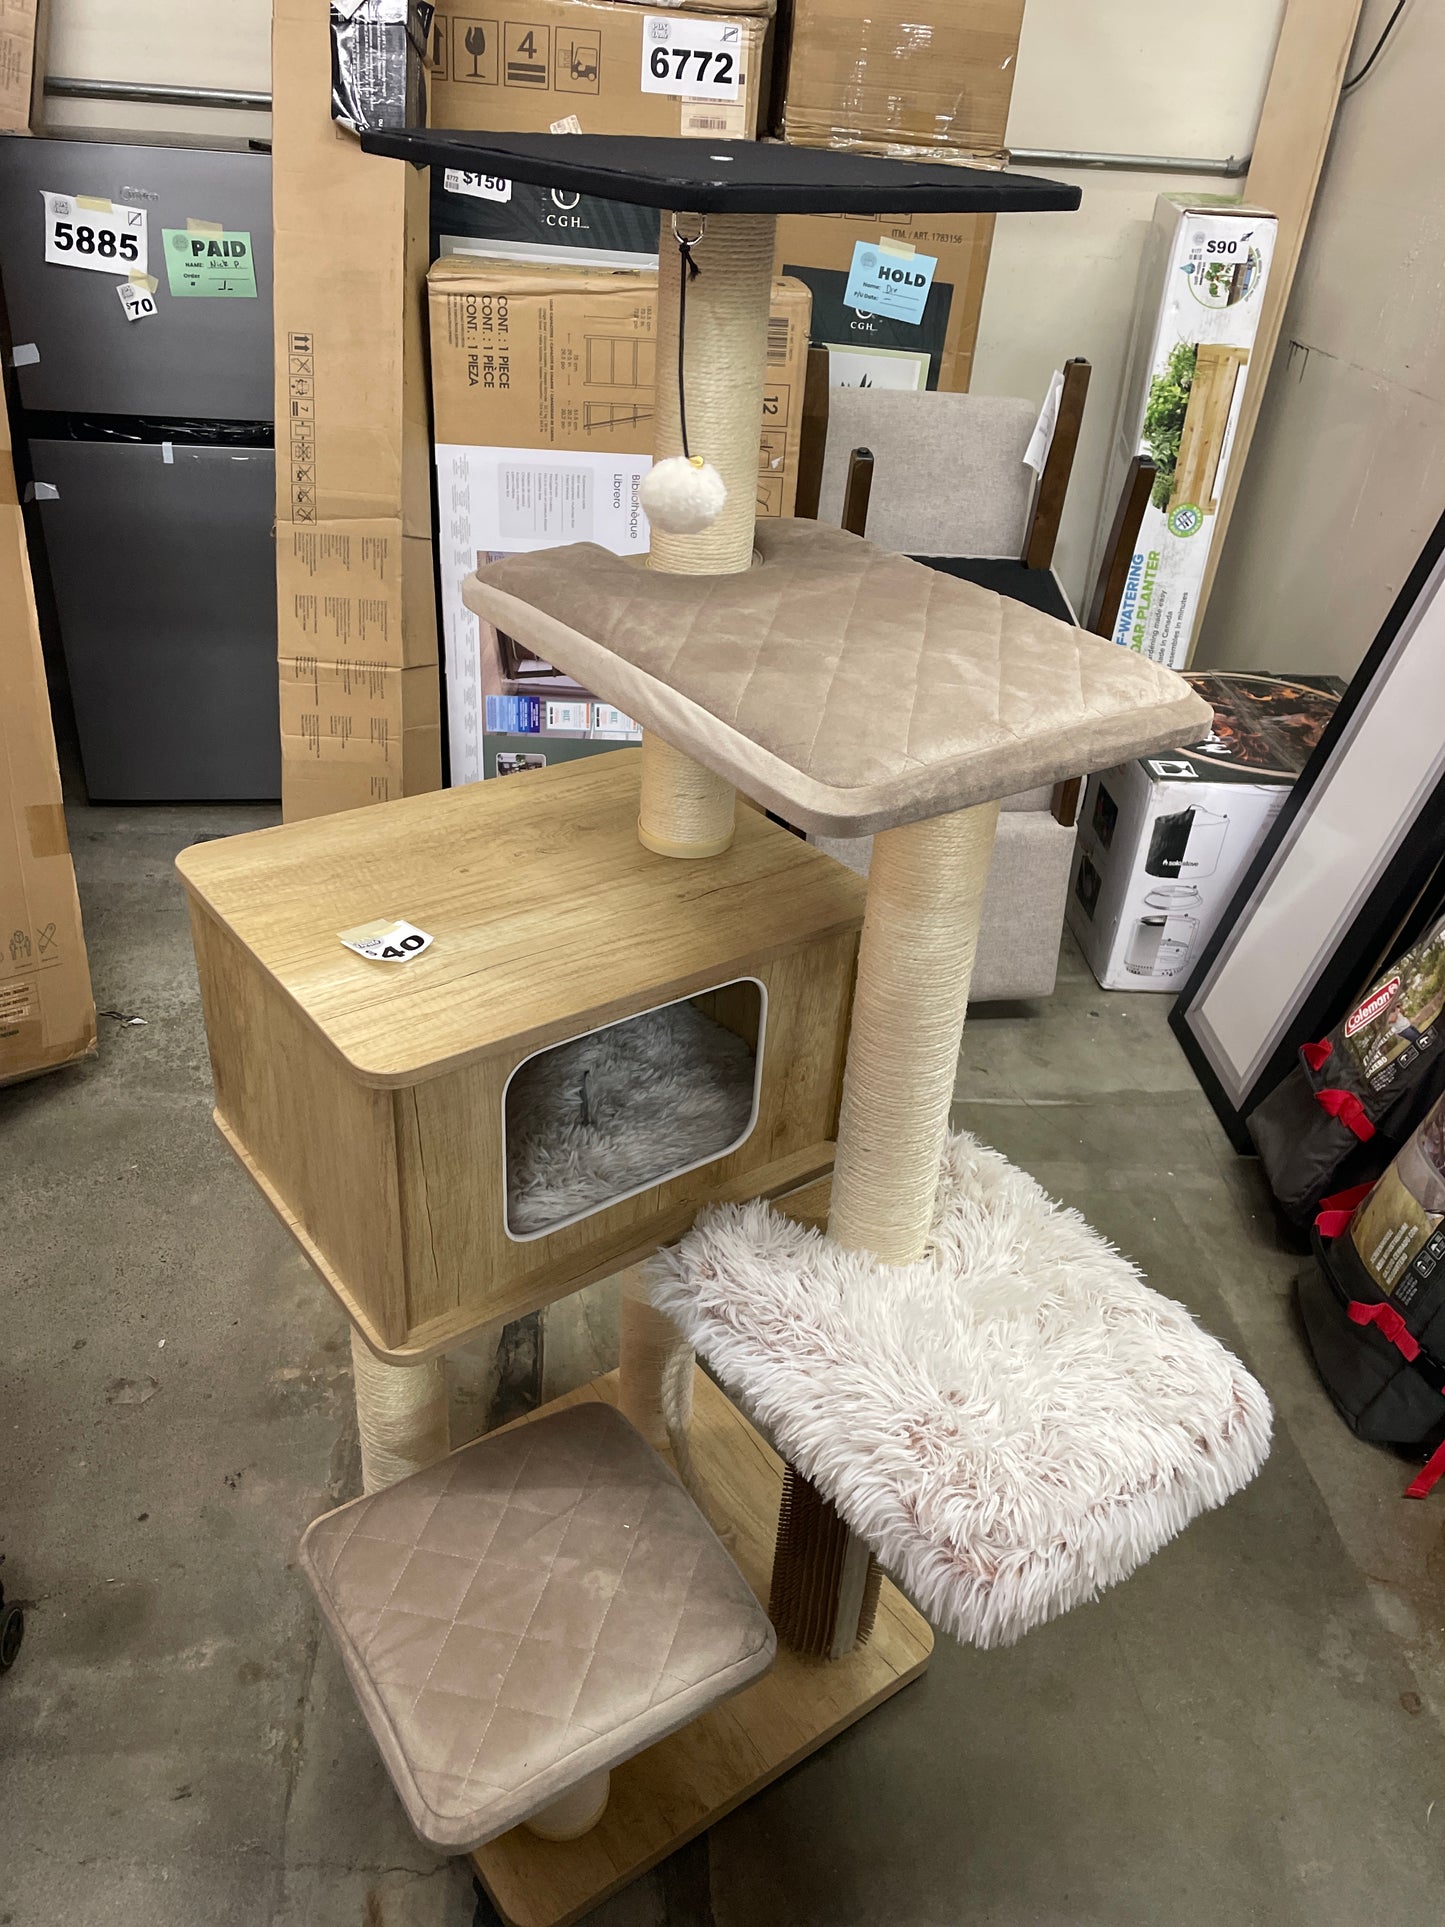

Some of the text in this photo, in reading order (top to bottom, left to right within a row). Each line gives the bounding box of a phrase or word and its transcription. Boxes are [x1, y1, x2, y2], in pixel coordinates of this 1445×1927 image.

[517, 30, 538, 59] 4
[650, 46, 734, 84] 6772
[462, 172, 506, 192] $150
[546, 214, 581, 228] CGH
[914, 231, 930, 241] ART.
[53, 221, 139, 262] 5885
[191, 240, 246, 257] PAID
[862, 282, 880, 290] Name:
[878, 265, 926, 288] HOLD
[126, 298, 153, 315] $70
[466, 294, 478, 333] CONT.
[864, 293, 879, 301] Date:
[481, 295, 493, 335] CONT.
[497, 295, 509, 335] CONT.
[850, 321, 873, 331] CGH
[468, 354, 479, 387] PIEZA
[483, 355, 497, 388] PIÈCE
[499, 356, 510, 389] PIECE
[763, 395, 779, 415] 12
[613, 473, 623, 509] Librero
[629, 474, 641, 539] Bibliothèque
[1136, 550, 1160, 620] PLANTER
[1154, 608, 1162, 629] made
[1158, 590, 1168, 607] easy
[1162, 611, 1173, 638] Canada
[1167, 631, 1180, 668] Assembles
[1177, 592, 1188, 621] minutes
[1348, 990, 1390, 1029] Coleman
